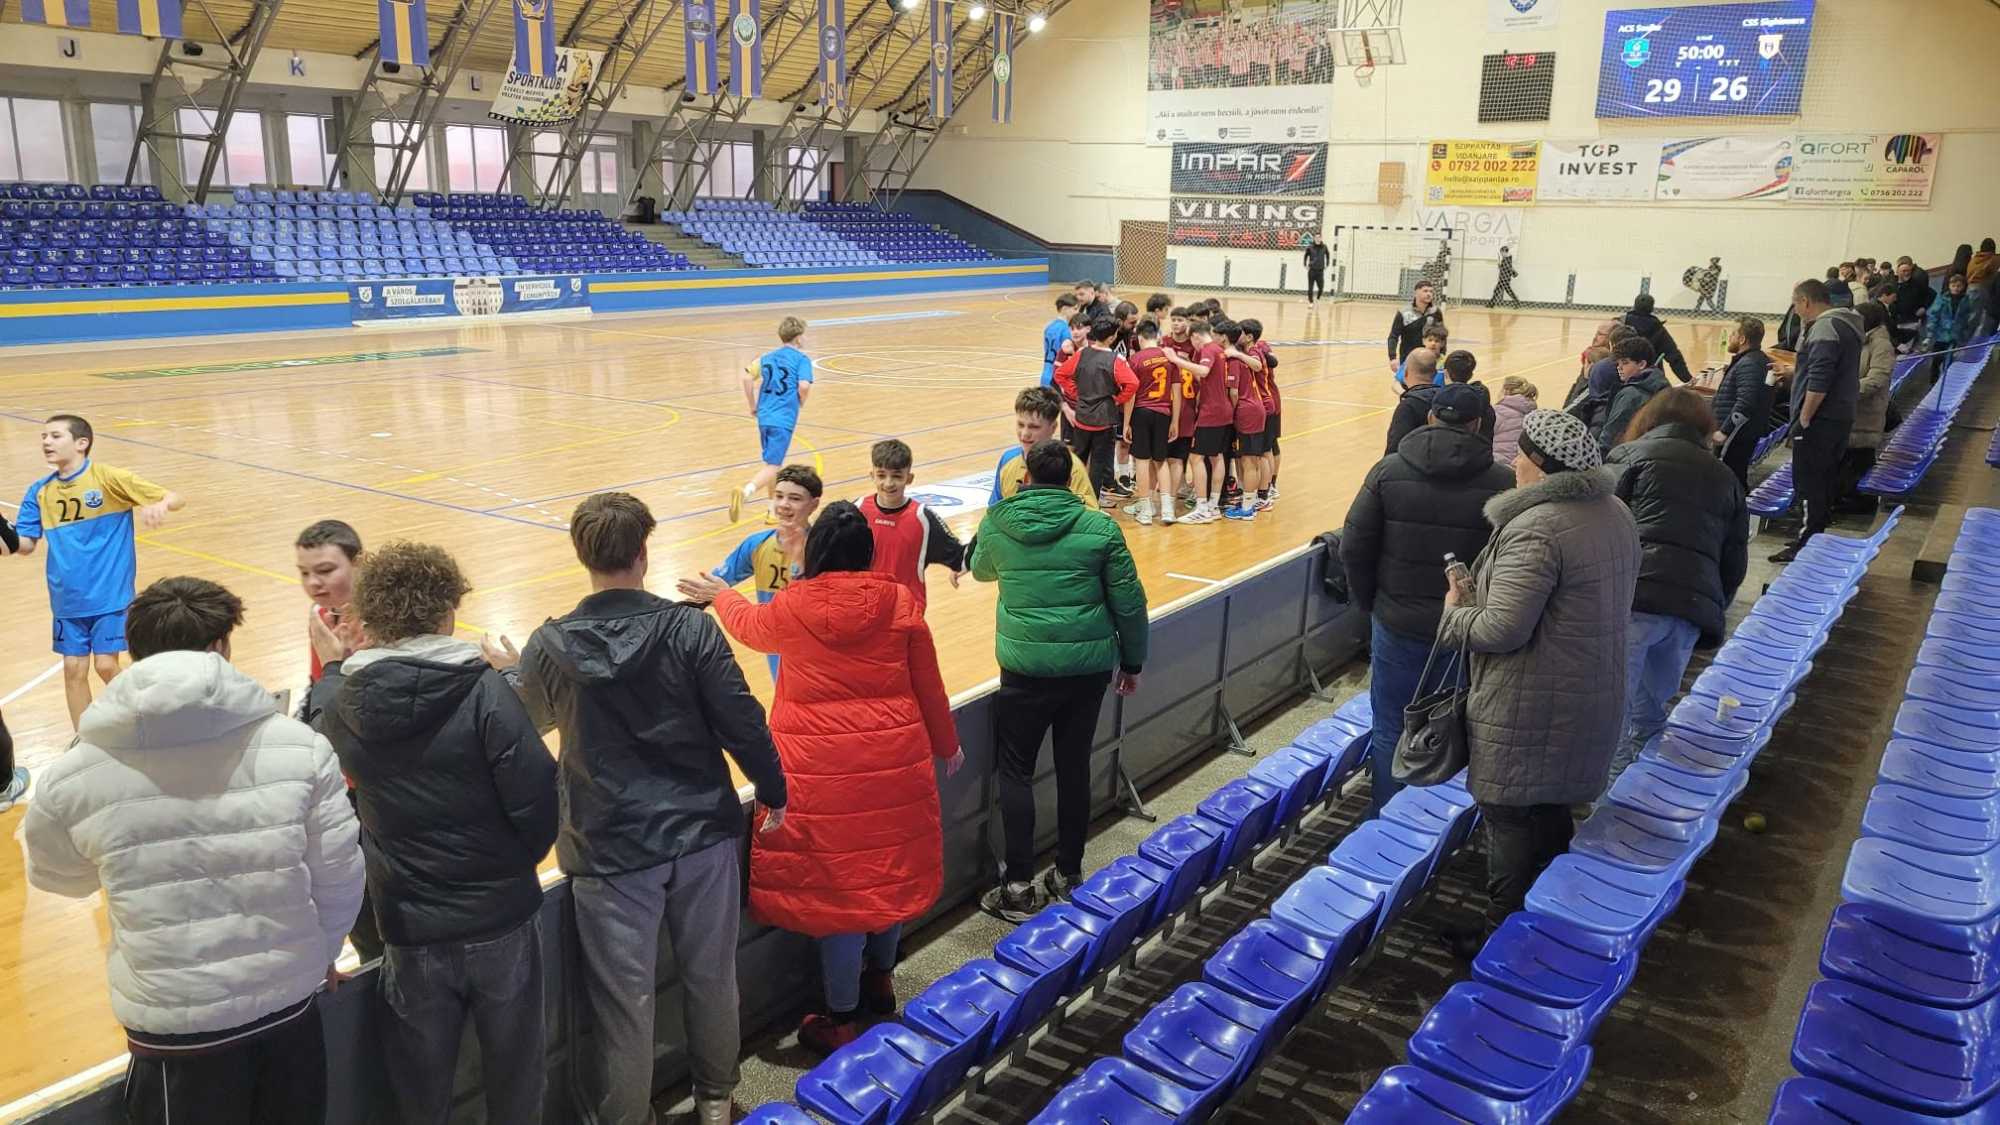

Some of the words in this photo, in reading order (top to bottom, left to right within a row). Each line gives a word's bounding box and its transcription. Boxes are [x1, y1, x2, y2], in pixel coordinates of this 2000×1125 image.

[63, 39, 75, 58] J
[1677, 45, 1725, 60] 50:00
[290, 58, 304, 77] K
[471, 75, 480, 91] L
[1643, 78, 1682, 103] 29
[1709, 76, 1748, 101] 26
[1181, 152, 1282, 172] IMPAR
[1448, 160, 1480, 172] 0792
[1484, 160, 1508, 172] 002
[1512, 160, 1537, 172] 222
[1559, 162, 1638, 175] INVEST
[1176, 202, 1318, 221] VIKING
[1416, 210, 1513, 234] VARGA
[762, 364, 790, 396] 23
[1181, 367, 1195, 399] 8
[56, 497, 86, 522] 22
[769, 563, 788, 590] 25
